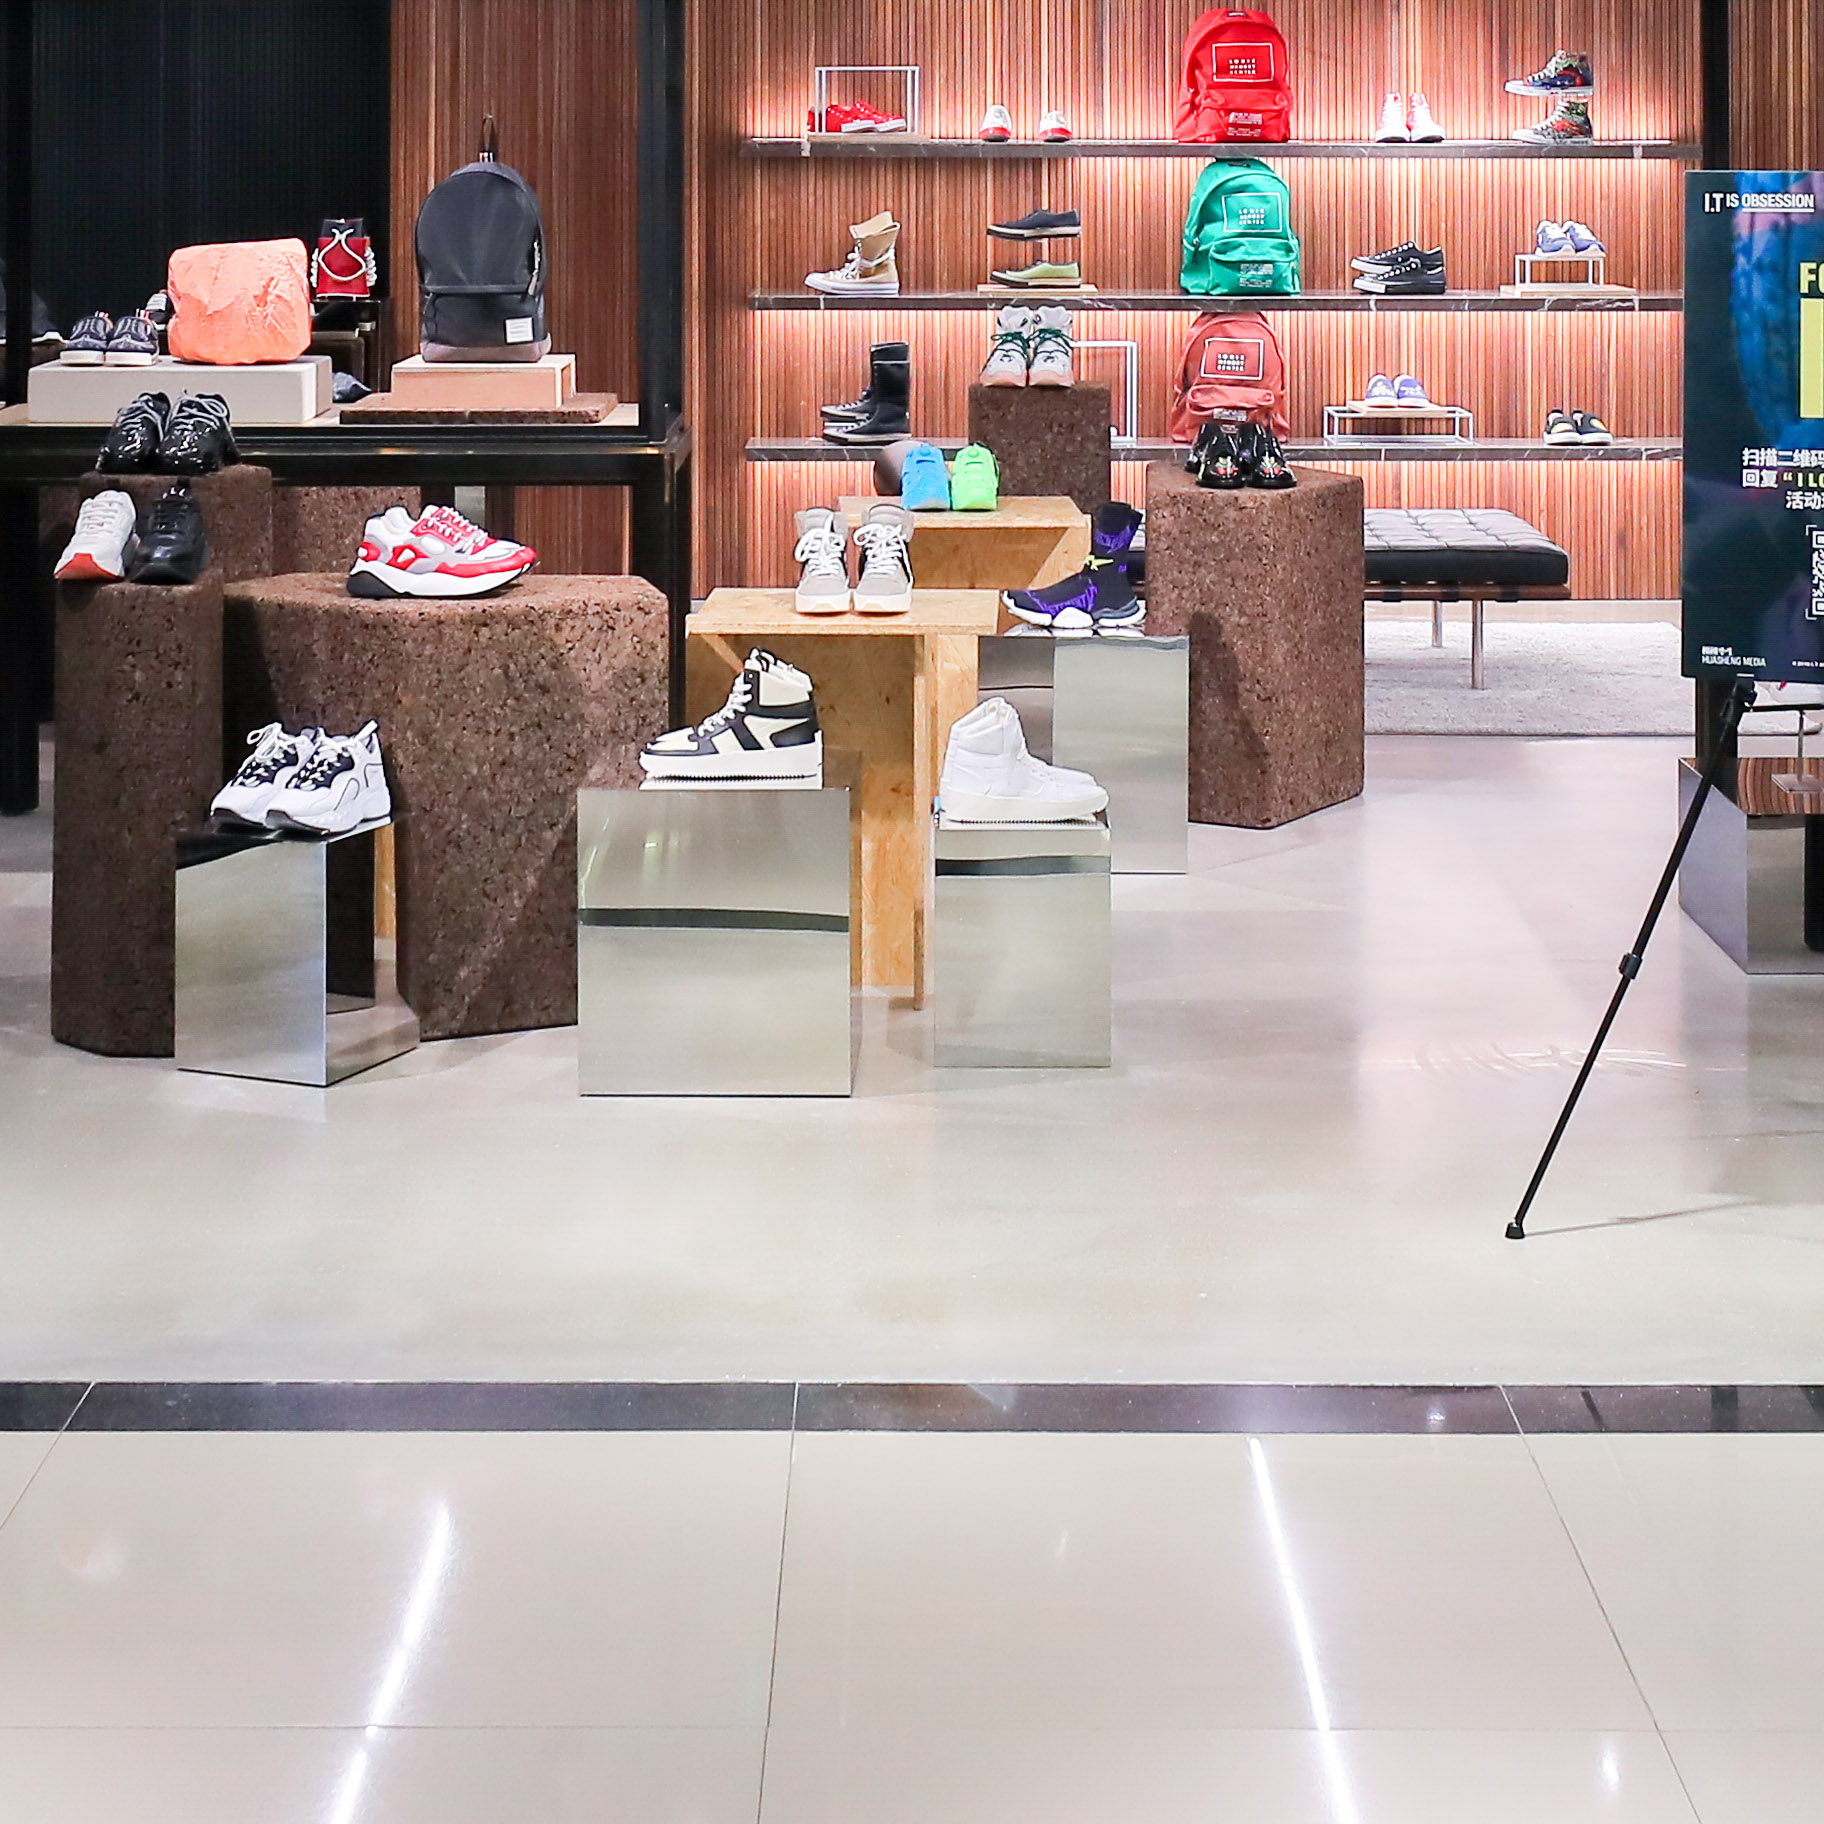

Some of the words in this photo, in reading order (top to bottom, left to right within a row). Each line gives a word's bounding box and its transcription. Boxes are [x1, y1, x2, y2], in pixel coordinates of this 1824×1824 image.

[1704, 192, 1724, 212] I.T
[1726, 193, 1739, 208] IS
[1741, 193, 1814, 208] OBSESSION
[1742, 469, 1779, 488] 回复
